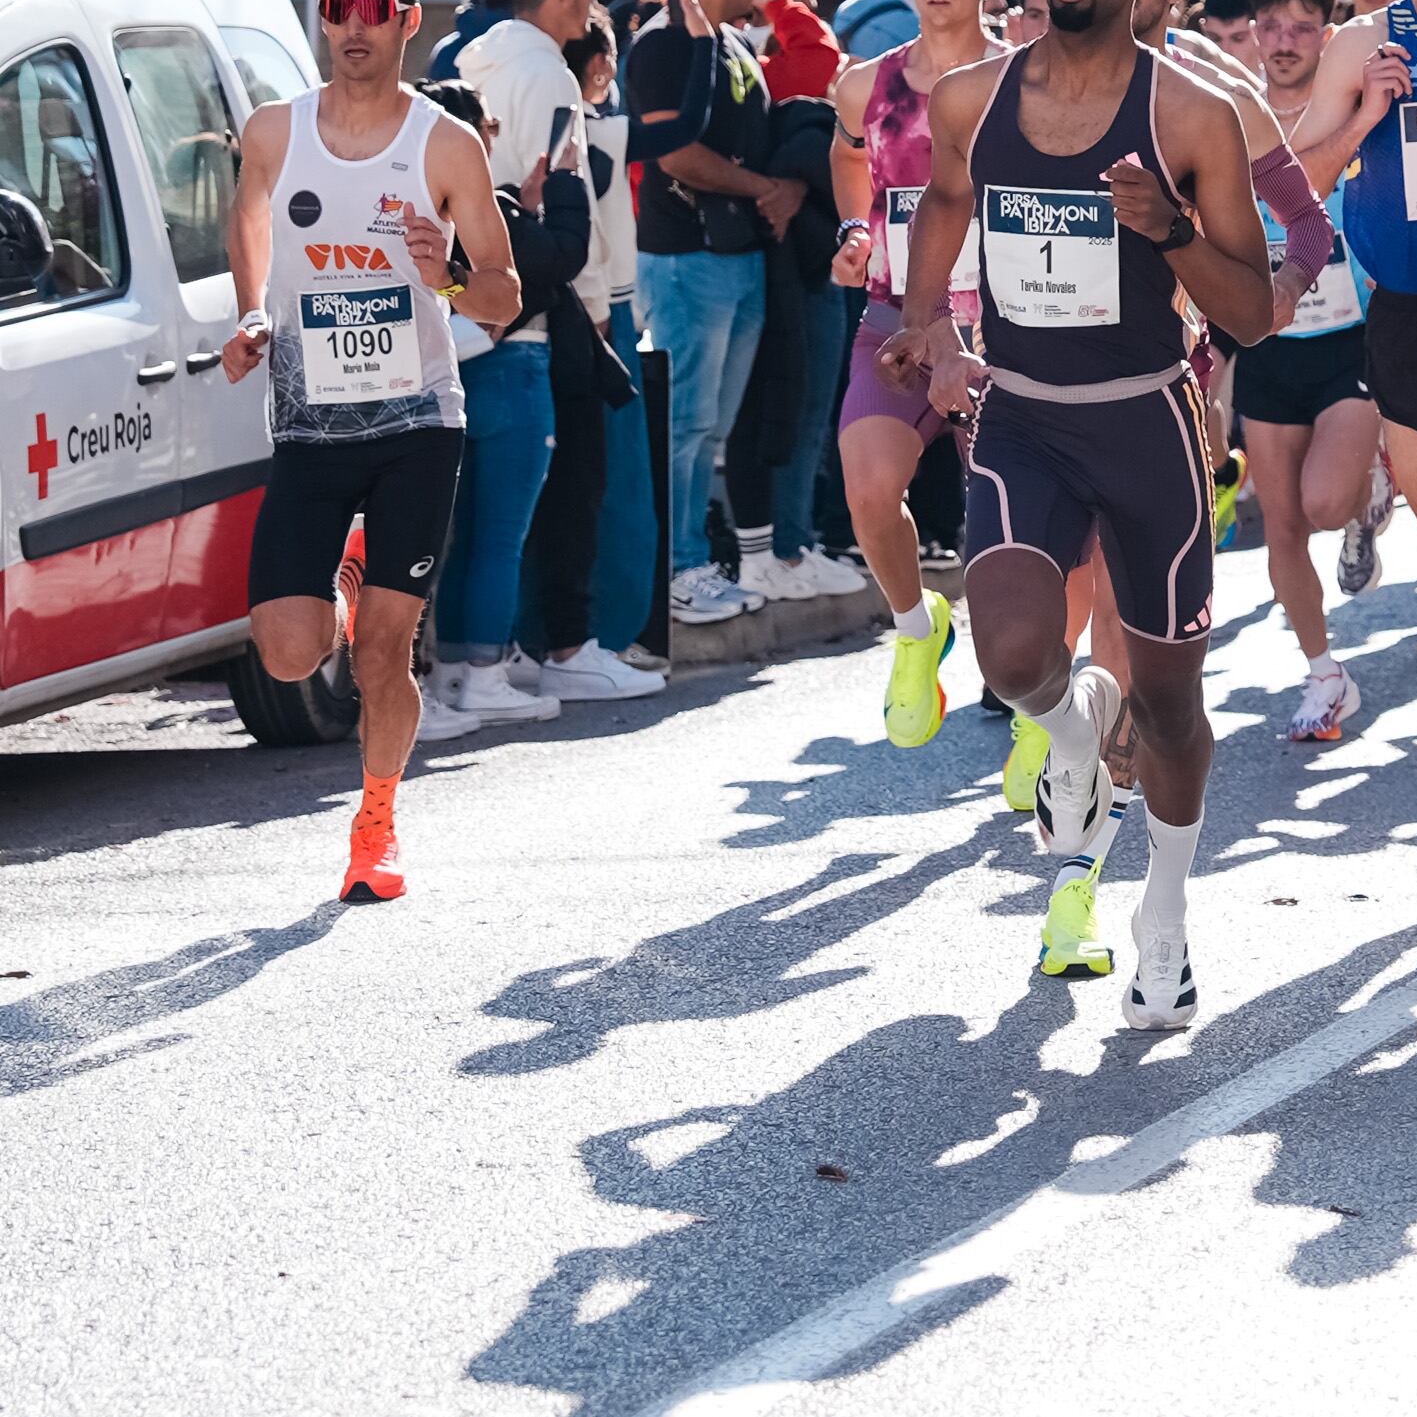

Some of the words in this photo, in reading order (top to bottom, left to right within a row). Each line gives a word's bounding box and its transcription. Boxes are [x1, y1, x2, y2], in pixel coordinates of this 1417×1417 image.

[1000, 193, 1040, 207] CURSA
[1000, 202, 1099, 222] PATRIMONI
[367, 226, 406, 236] MALLORCA
[1024, 218, 1070, 234] IBIZA
[1088, 236, 1113, 246] 2025
[305, 244, 392, 271] VIVA
[1039, 240, 1052, 274] 1
[1045, 281, 1077, 294] Novales
[312, 294, 348, 305] CURSA
[312, 295, 399, 317] PATRIMONI
[336, 311, 376, 326] IBIZA
[327, 327, 393, 359] 1090
[67, 425, 110, 464] Creu
[114, 402, 152, 453] Roja
